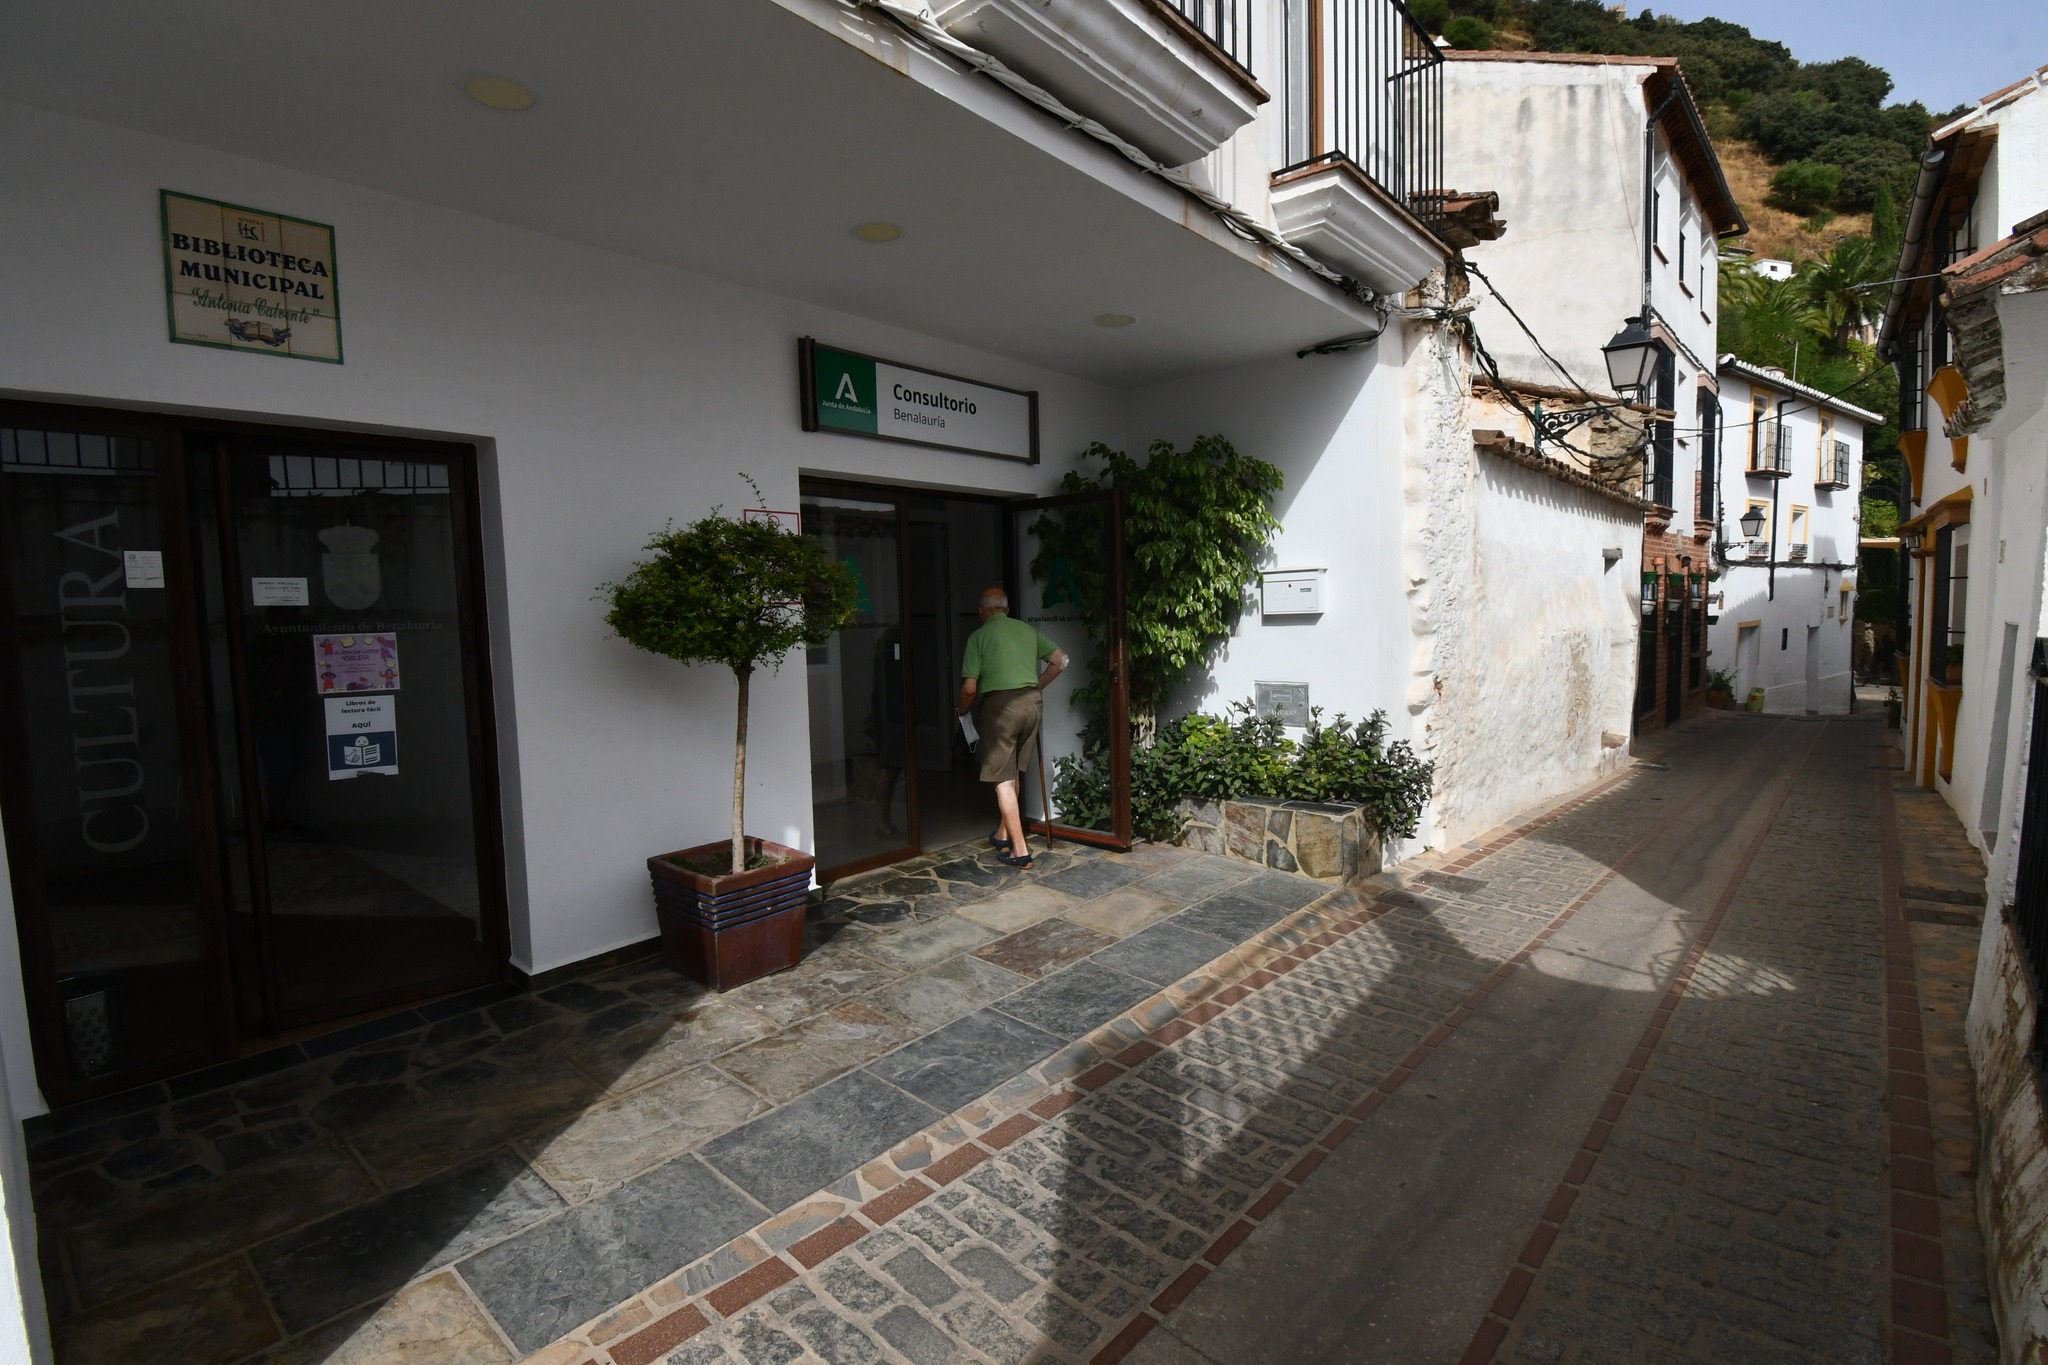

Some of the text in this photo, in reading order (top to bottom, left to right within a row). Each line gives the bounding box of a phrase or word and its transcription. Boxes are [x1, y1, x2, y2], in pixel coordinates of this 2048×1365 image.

[171, 232, 329, 278] BIBLIOTECA
[179, 259, 325, 300] MUNICIPAL
[822, 400, 872, 414] Junta de Andalucía
[893, 383, 977, 415] Consultorio
[893, 408, 946, 428] Benalauría
[262, 622, 357, 636] Ayuntamiento
[358, 621, 372, 631] de
[52, 508, 150, 854] CULTURA
[352, 721, 371, 729] AQUÍ
